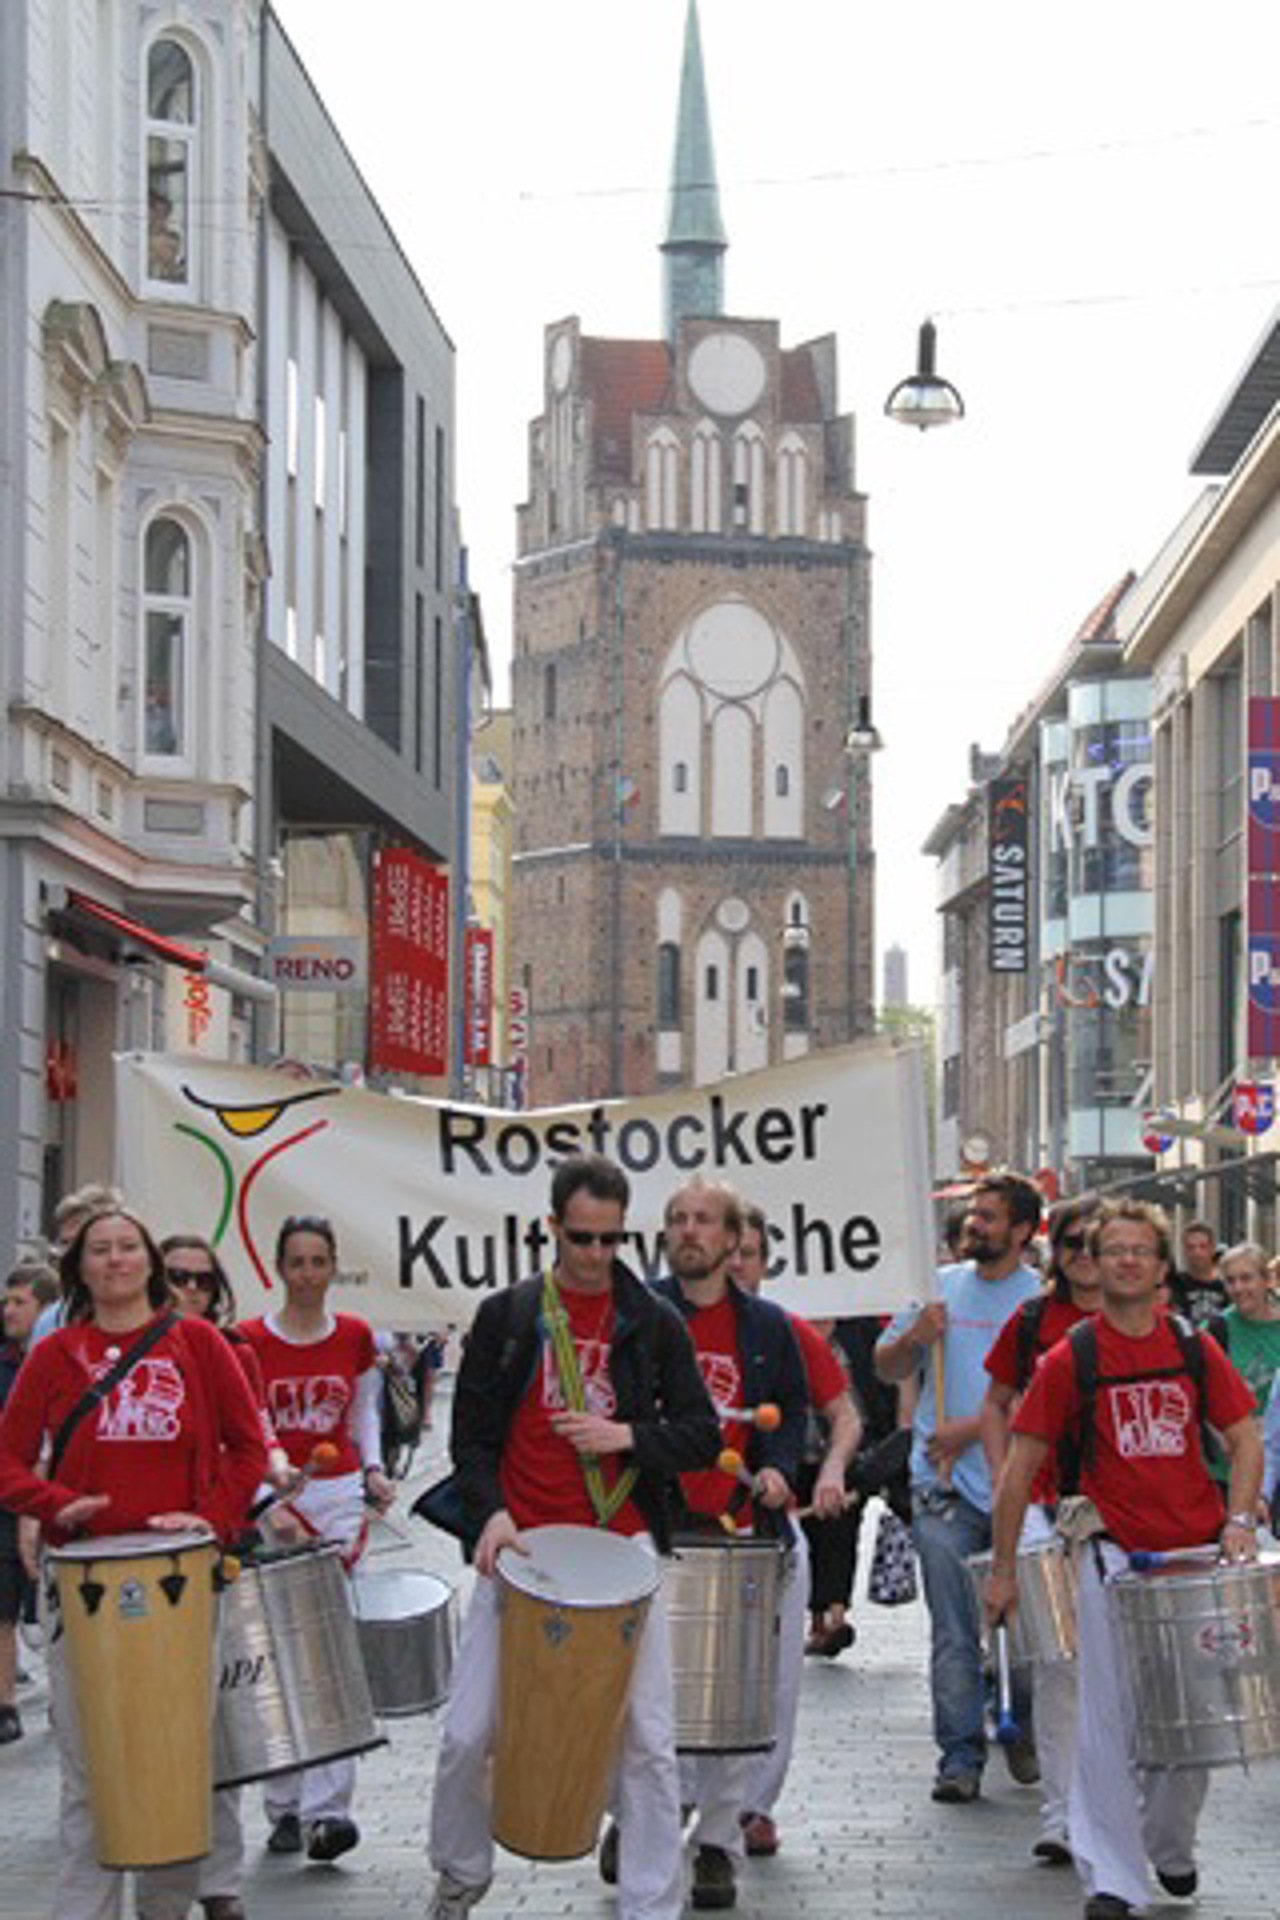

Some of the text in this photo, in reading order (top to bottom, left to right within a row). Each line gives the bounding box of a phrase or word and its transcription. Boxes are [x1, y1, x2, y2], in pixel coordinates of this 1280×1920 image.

[992, 845, 1026, 972] SATURN
[274, 957, 356, 982] RENO
[1104, 948, 1153, 1009] S
[438, 1094, 827, 1176] Rostocker
[398, 1202, 881, 1289] Kultwche
